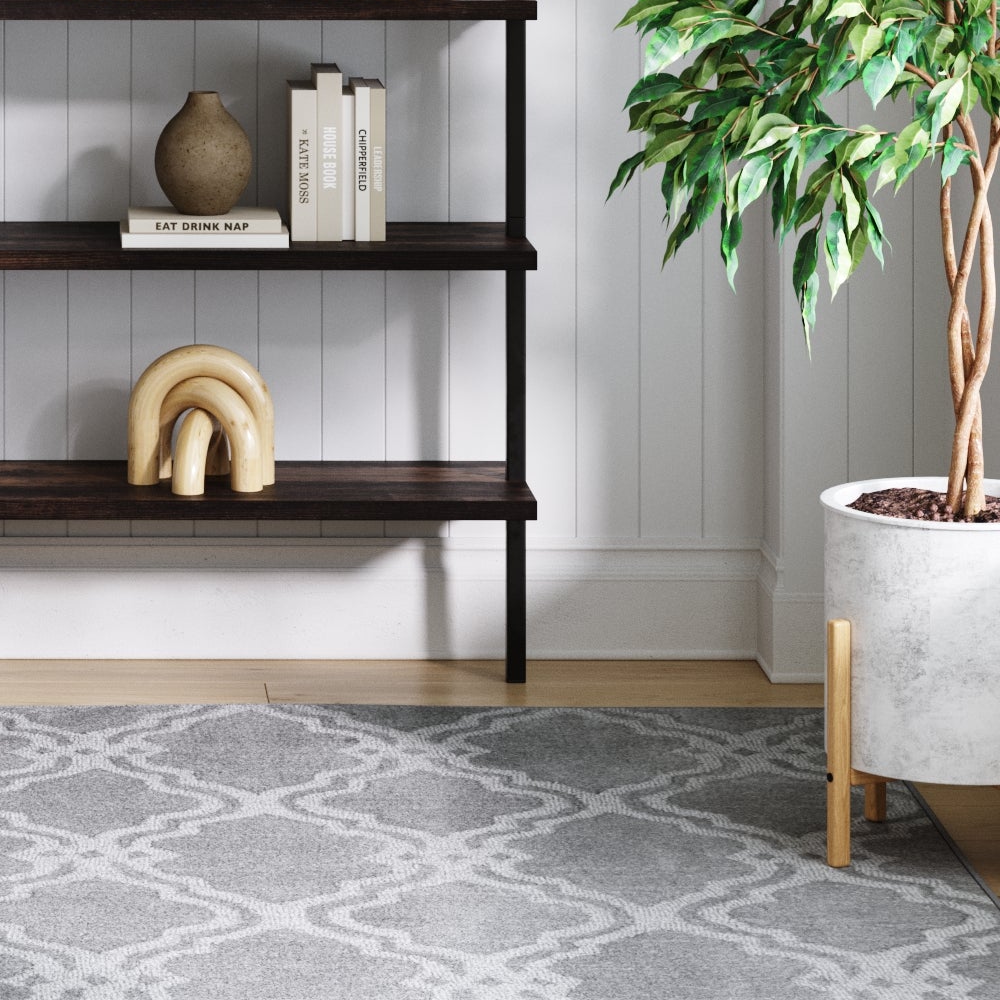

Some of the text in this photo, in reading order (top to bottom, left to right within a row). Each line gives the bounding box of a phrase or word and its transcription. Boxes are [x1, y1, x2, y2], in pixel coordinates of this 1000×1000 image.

[299, 139, 309, 204] KATE MOSS
[323, 126, 337, 189] HOUSE BOOK
[358, 129, 367, 192] CHIPPERFIELD
[373, 146, 383, 192] LEADERSHIP
[155, 222, 249, 231] EAT DRINK NAP
